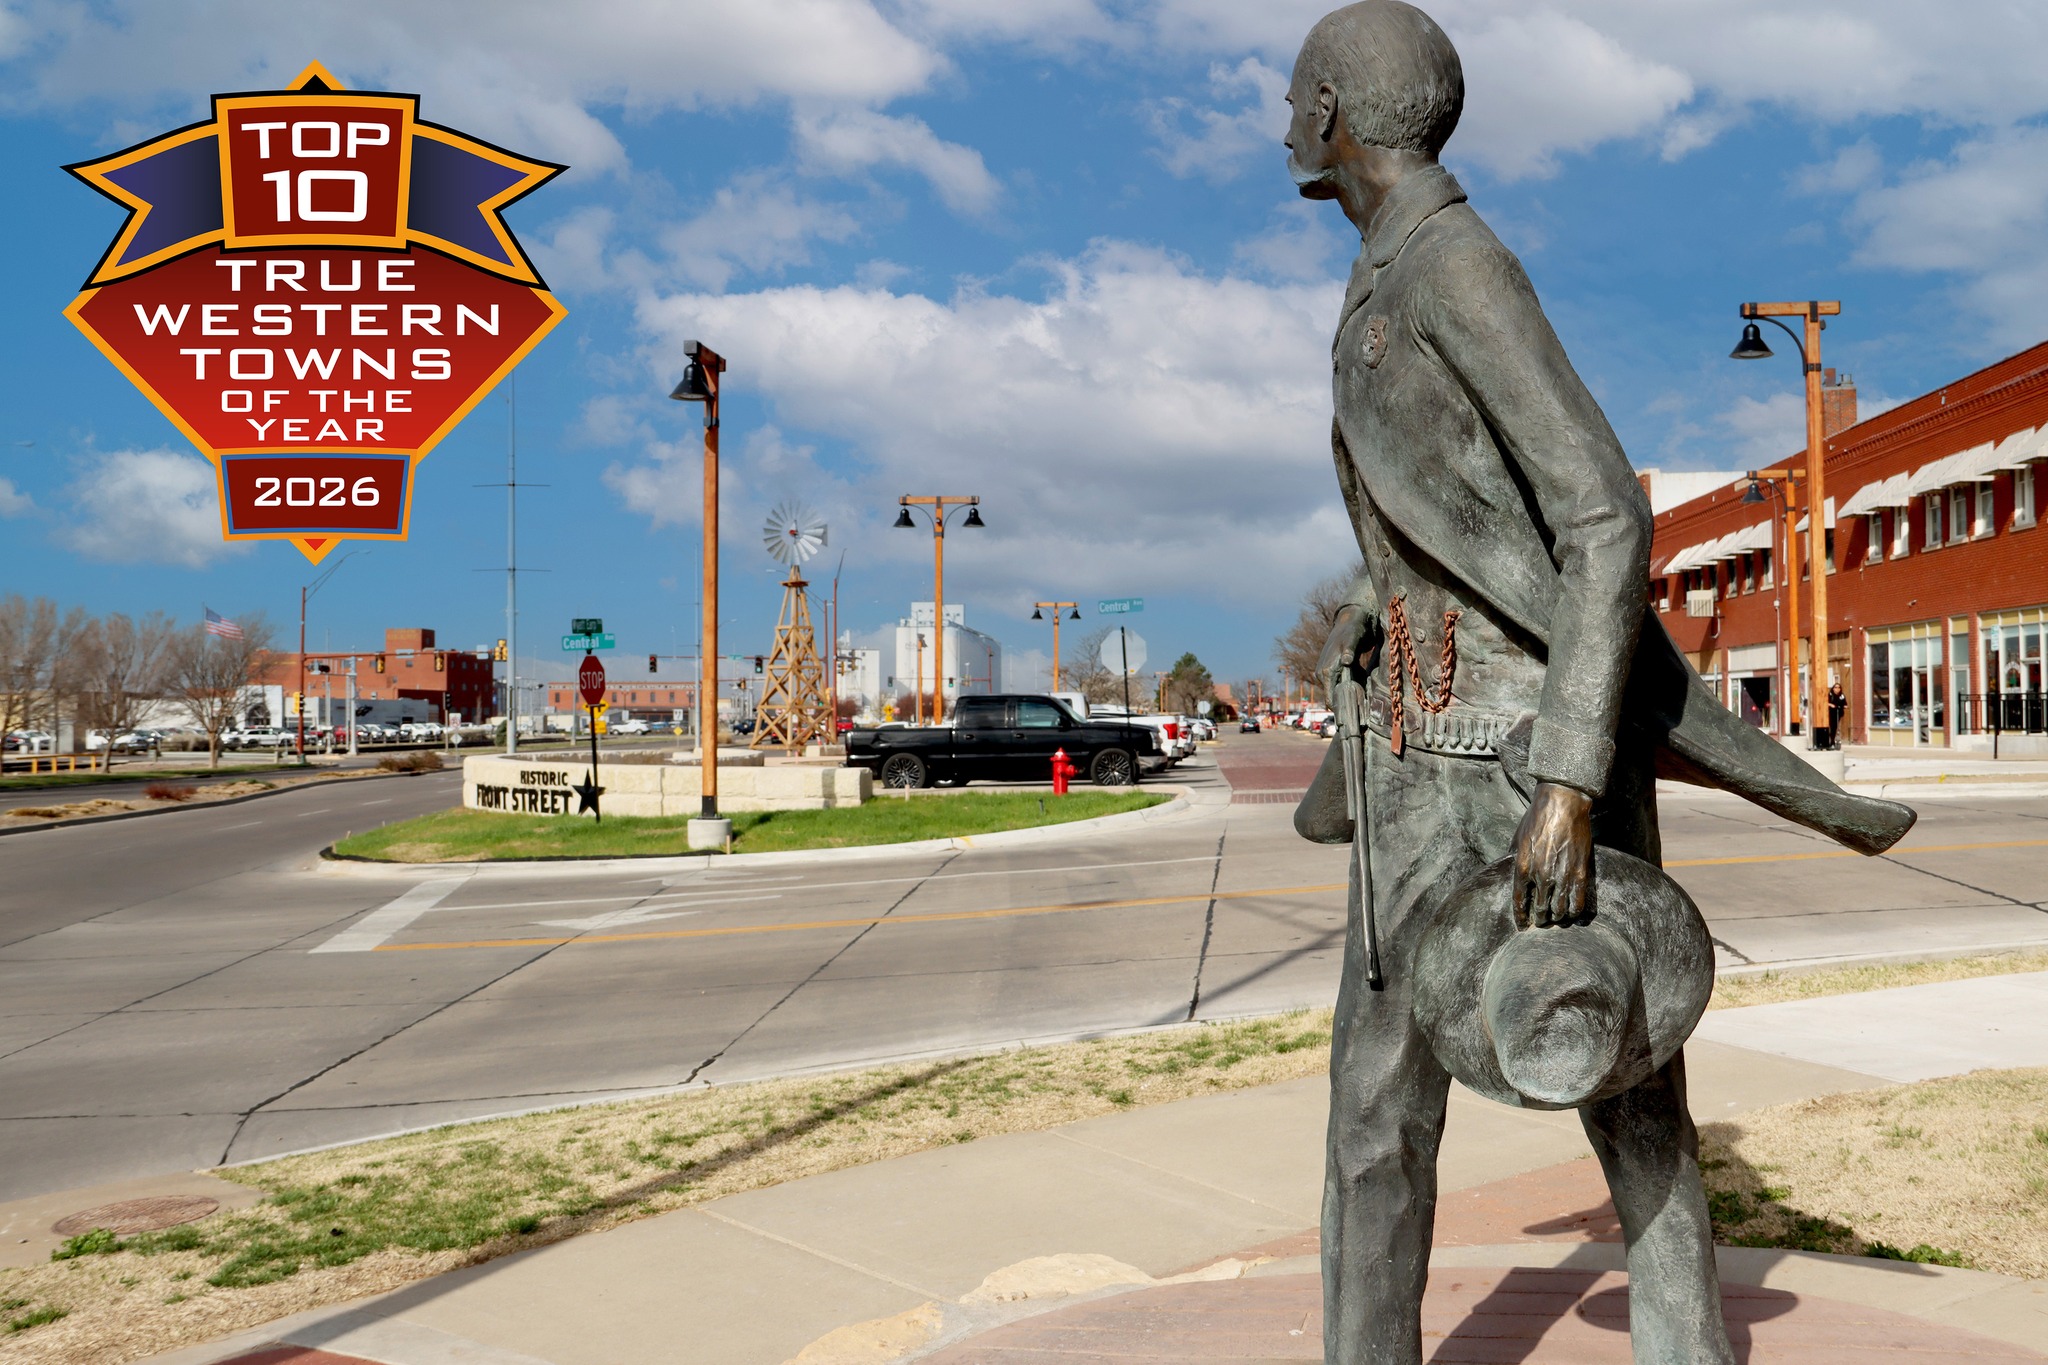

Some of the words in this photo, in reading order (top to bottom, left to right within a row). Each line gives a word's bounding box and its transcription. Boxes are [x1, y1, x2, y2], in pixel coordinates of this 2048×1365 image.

[1099, 600, 1130, 613] Central
[563, 636, 600, 649] Central
[581, 671, 604, 690] STOP
[520, 770, 568, 786] HISTORIC
[476, 783, 509, 810] FRONT
[512, 787, 573, 815] STREET
